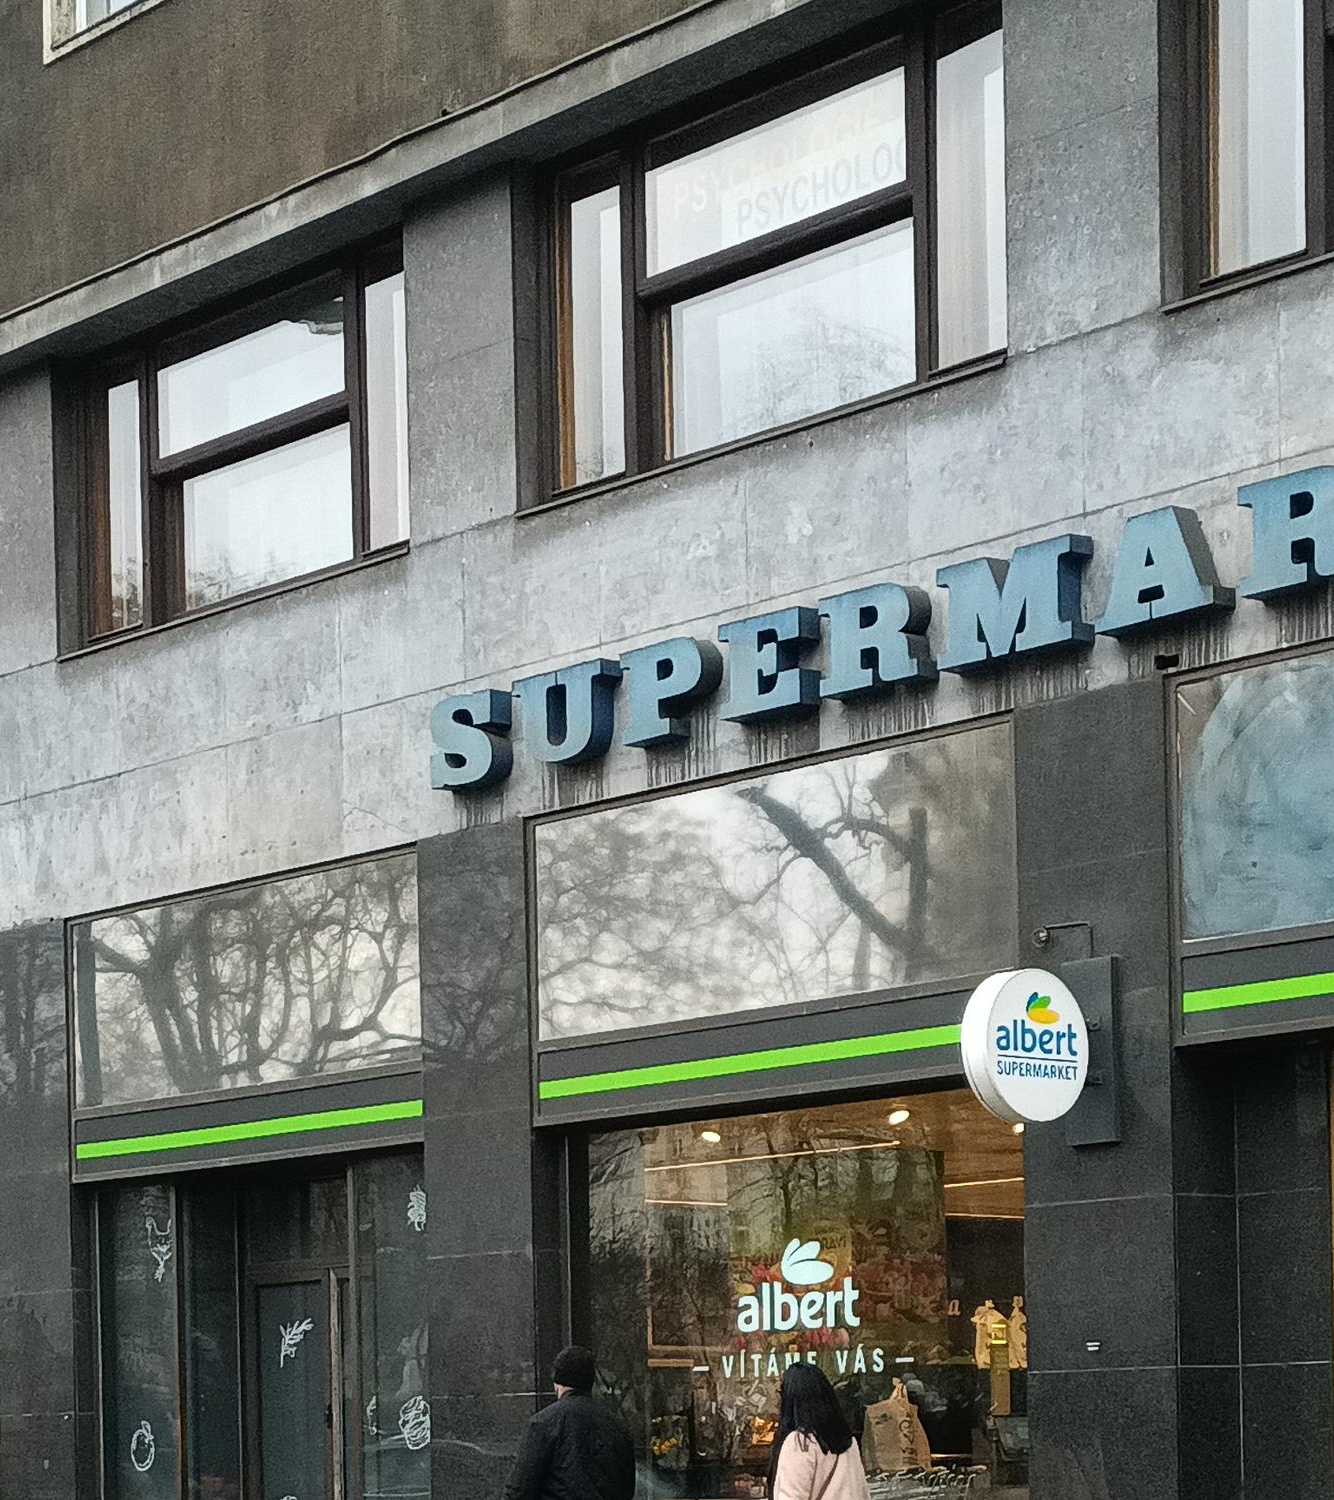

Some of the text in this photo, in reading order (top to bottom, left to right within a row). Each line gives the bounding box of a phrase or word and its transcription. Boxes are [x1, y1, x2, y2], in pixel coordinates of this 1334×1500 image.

[996, 1019, 1078, 1056] albert
[997, 1060, 1078, 1081] SUPERMARKET
[737, 1276, 861, 1333] albert
[835, 1343, 885, 1374] VÁS
